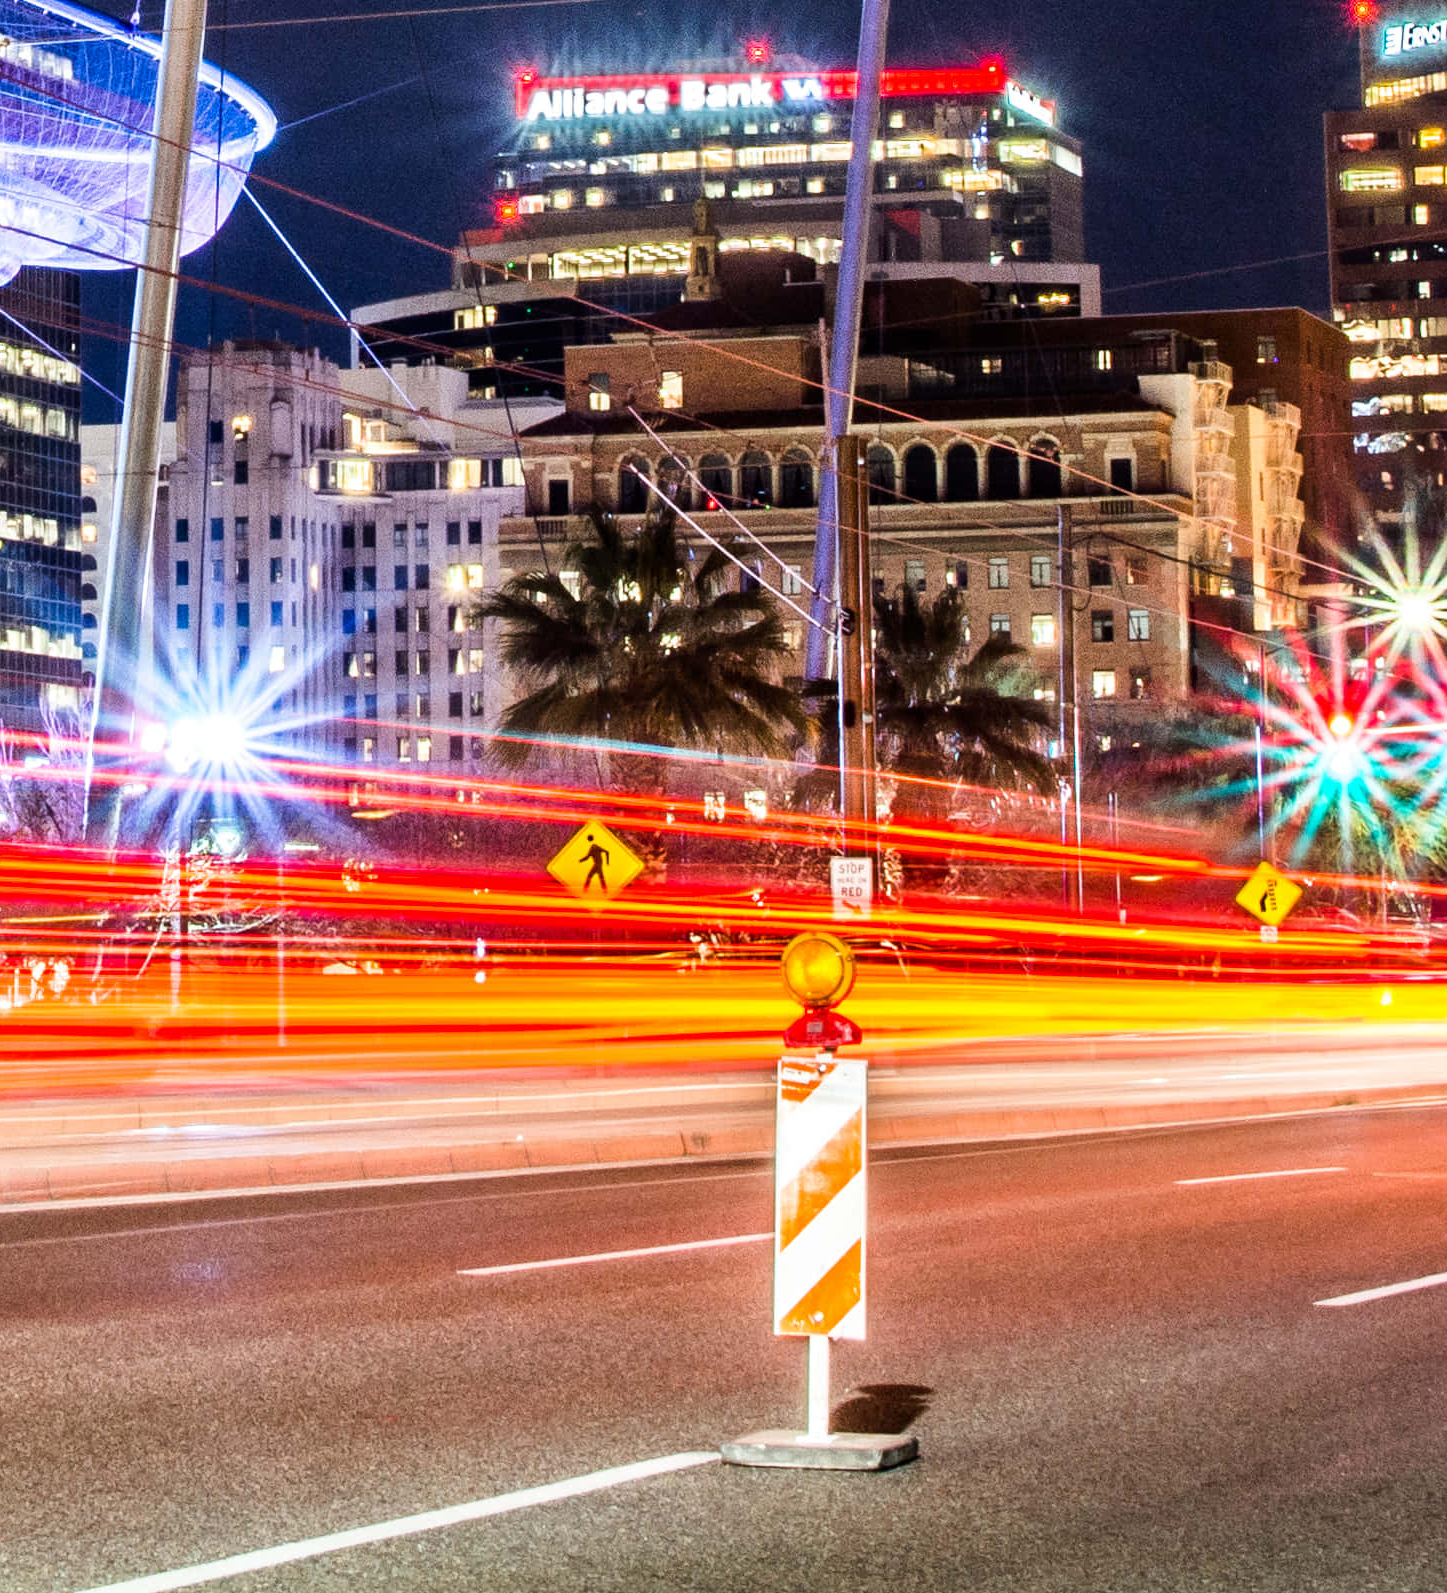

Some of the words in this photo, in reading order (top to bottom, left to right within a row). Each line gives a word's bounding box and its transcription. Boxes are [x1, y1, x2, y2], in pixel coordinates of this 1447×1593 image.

[527, 86, 669, 121] Alliance
[680, 77, 774, 111] Bank
[839, 864, 865, 874] STOP
[841, 887, 862, 896] RED
